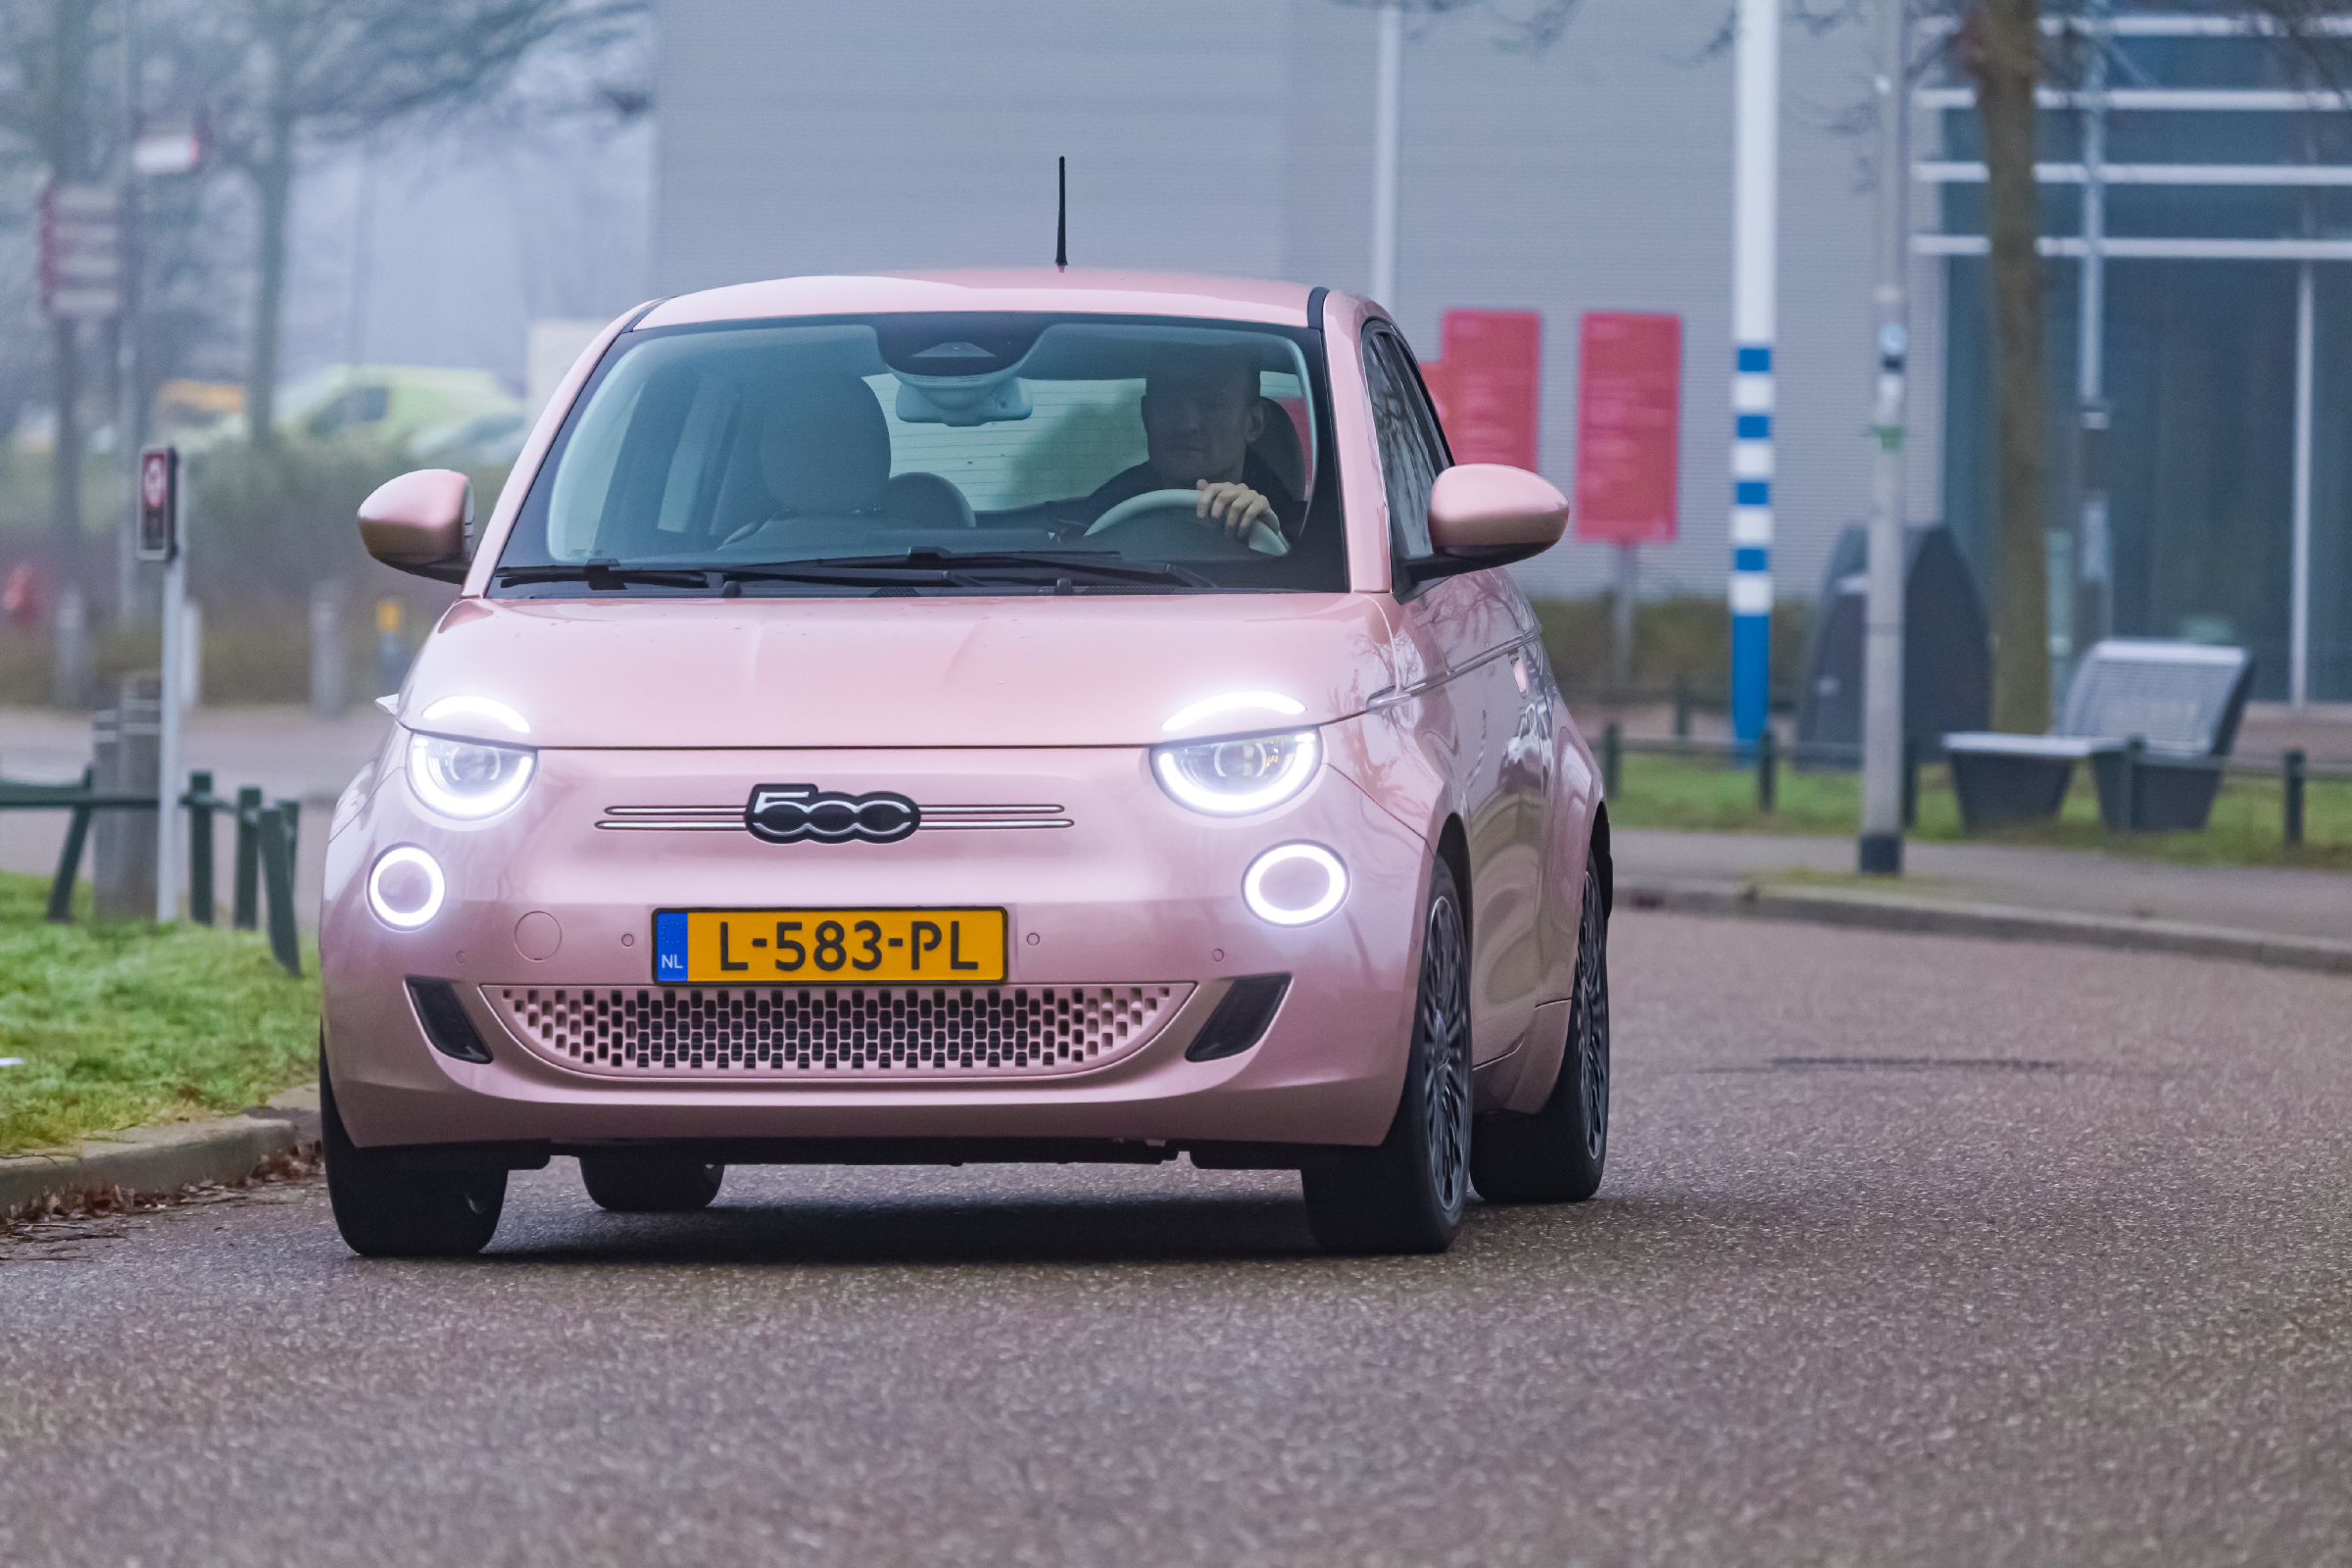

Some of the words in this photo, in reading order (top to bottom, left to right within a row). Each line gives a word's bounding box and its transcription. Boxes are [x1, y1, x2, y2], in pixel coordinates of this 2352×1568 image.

[753, 791, 912, 837] 500
[661, 954, 684, 969] NL
[719, 919, 979, 971] L-583-PL
